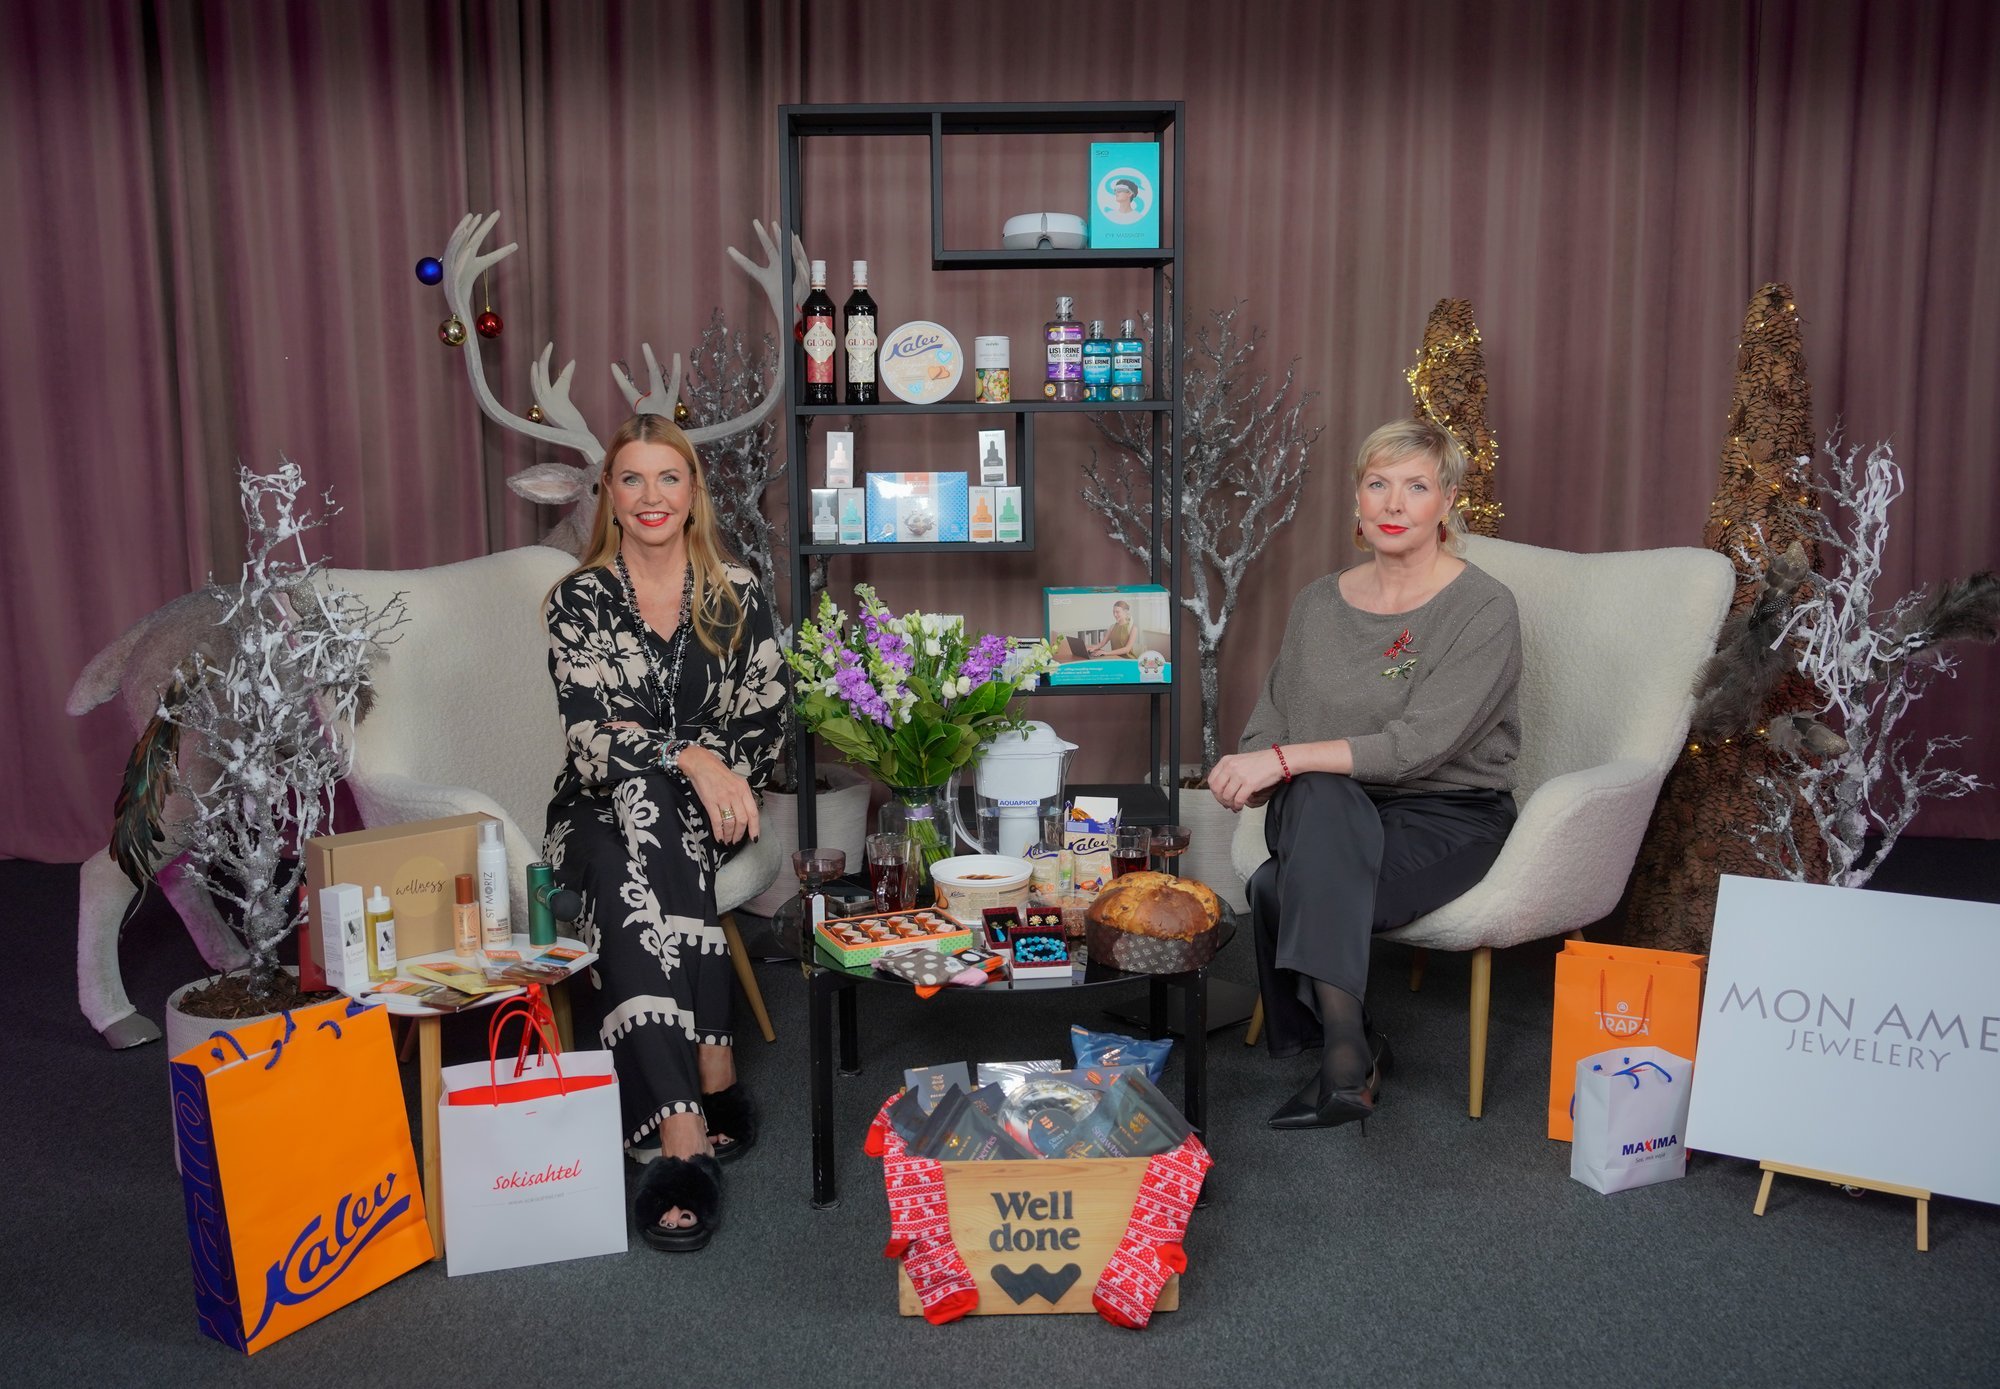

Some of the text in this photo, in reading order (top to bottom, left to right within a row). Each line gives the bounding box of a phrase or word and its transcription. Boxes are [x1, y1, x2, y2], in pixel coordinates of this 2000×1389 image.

[885, 335, 943, 362] Kalev
[1067, 837, 1109, 855] Kalev
[395, 879, 446, 896] wellness
[483, 872, 494, 905] MORIZ
[486, 907, 495, 919] ST
[1598, 1016, 1650, 1036] TRAPA
[1718, 981, 2000, 1053] MON AME
[1785, 1029, 1951, 1072] JEWELERY
[1622, 1134, 1678, 1156] MAXIMA
[990, 1190, 1074, 1221] Well
[989, 1222, 1080, 1252] done
[246, 1172, 411, 1343] Kalev
